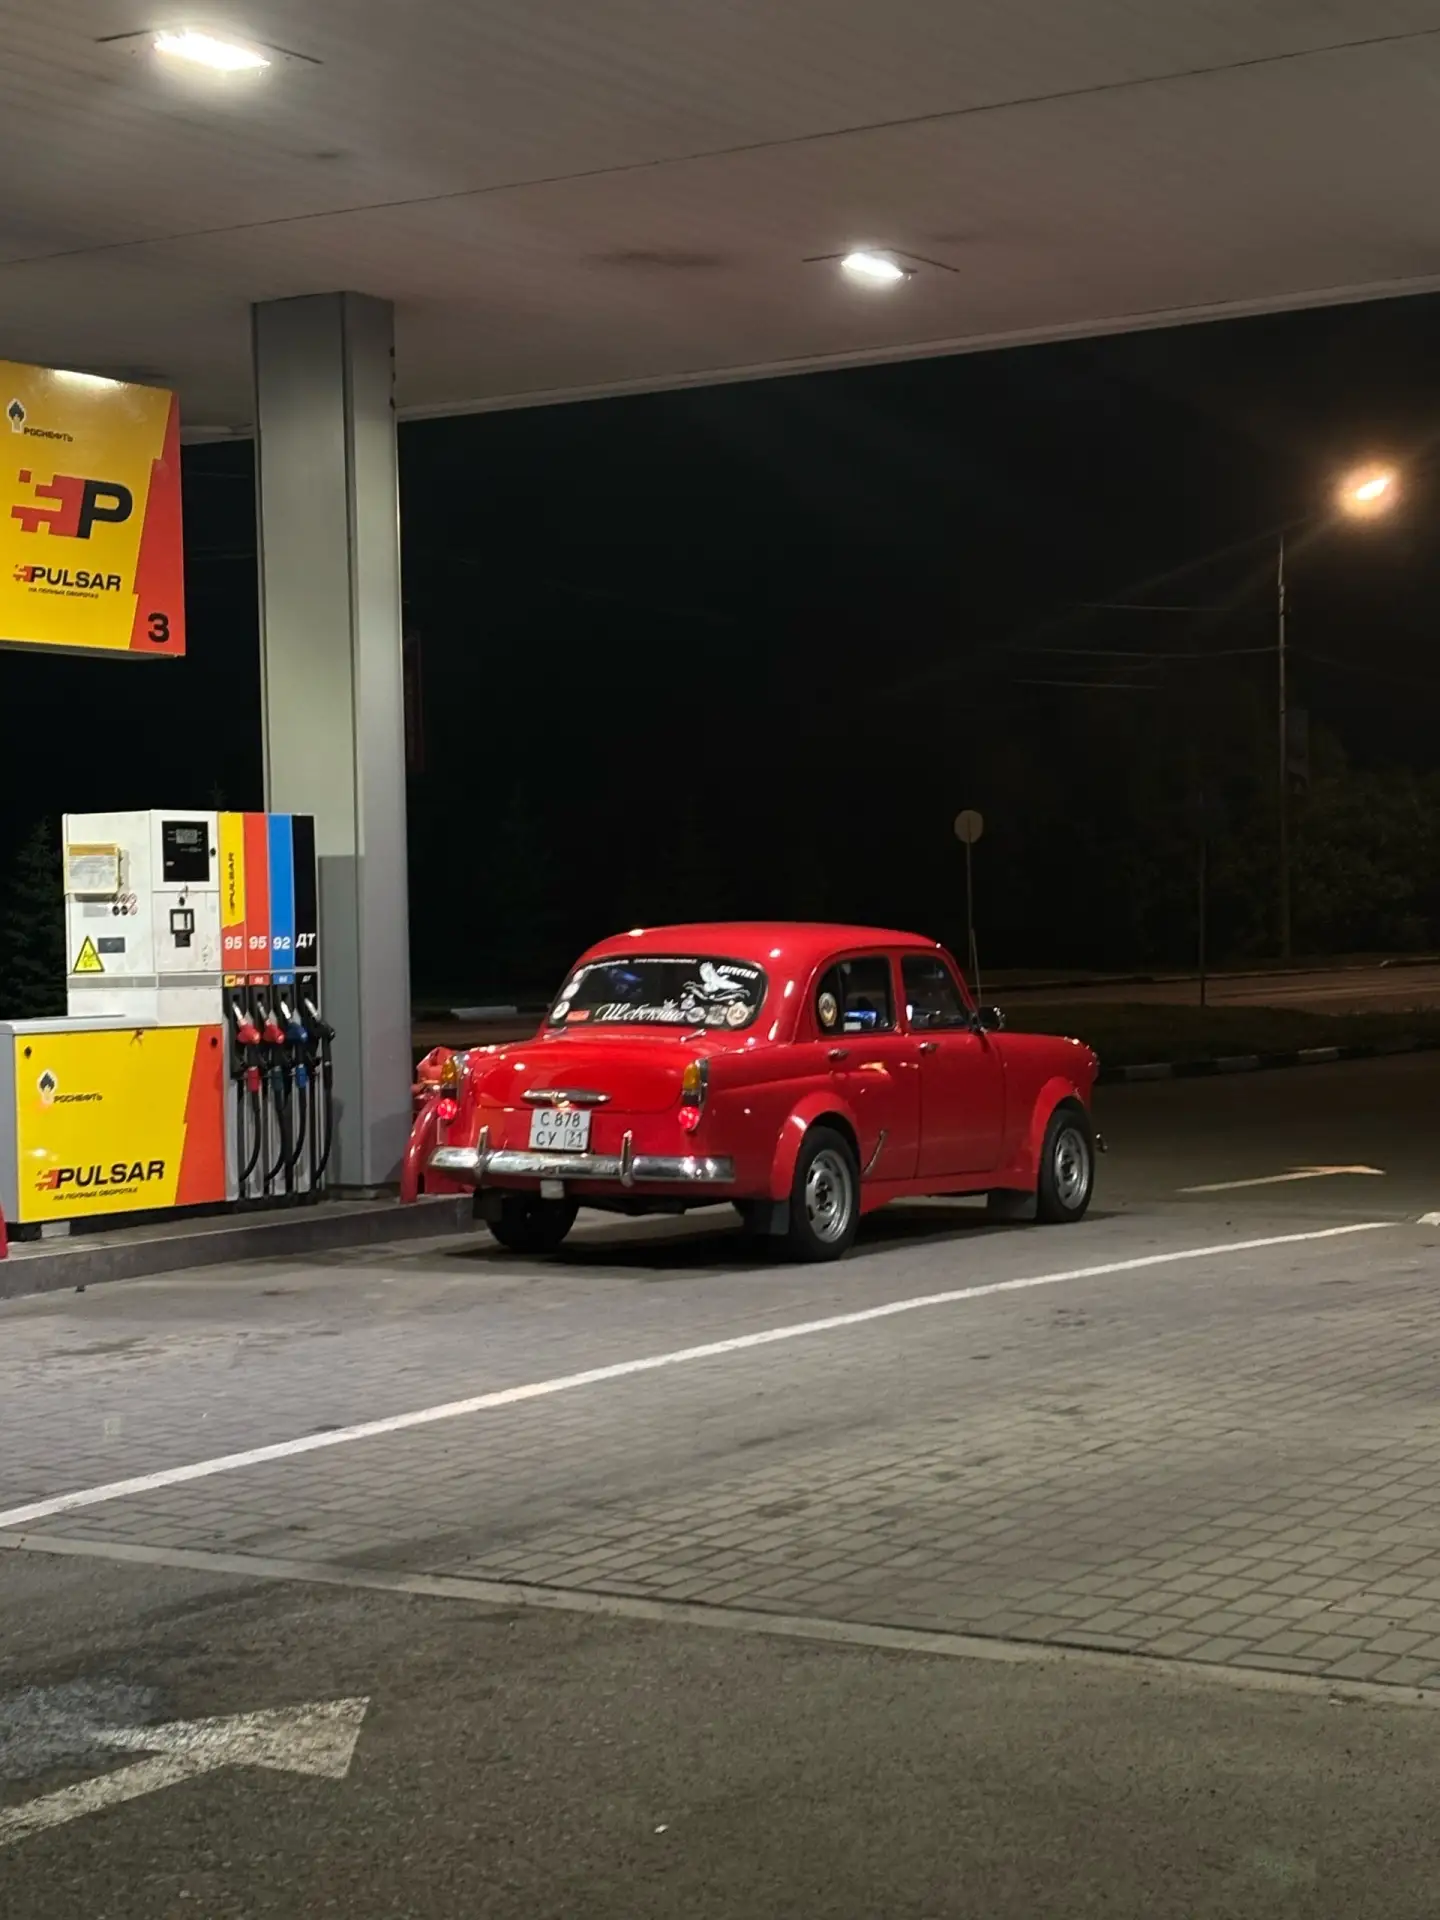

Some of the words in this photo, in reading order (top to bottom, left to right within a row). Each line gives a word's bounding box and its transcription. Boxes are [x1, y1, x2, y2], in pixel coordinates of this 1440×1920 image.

[24, 427, 74, 442] РОСНЕФТЬ
[30, 565, 122, 592] PULSAR
[148, 612, 170, 643] 3
[224, 935, 244, 950] 95
[249, 935, 268, 950] 95
[273, 936, 291, 950] 92
[296, 932, 316, 948] ДТ
[53, 1092, 103, 1103] РОСНЕФТЬ
[540, 1111, 550, 1126] С
[554, 1111, 581, 1128] 878
[536, 1130, 557, 1146] СУ
[56, 1160, 165, 1189] PULSAR
